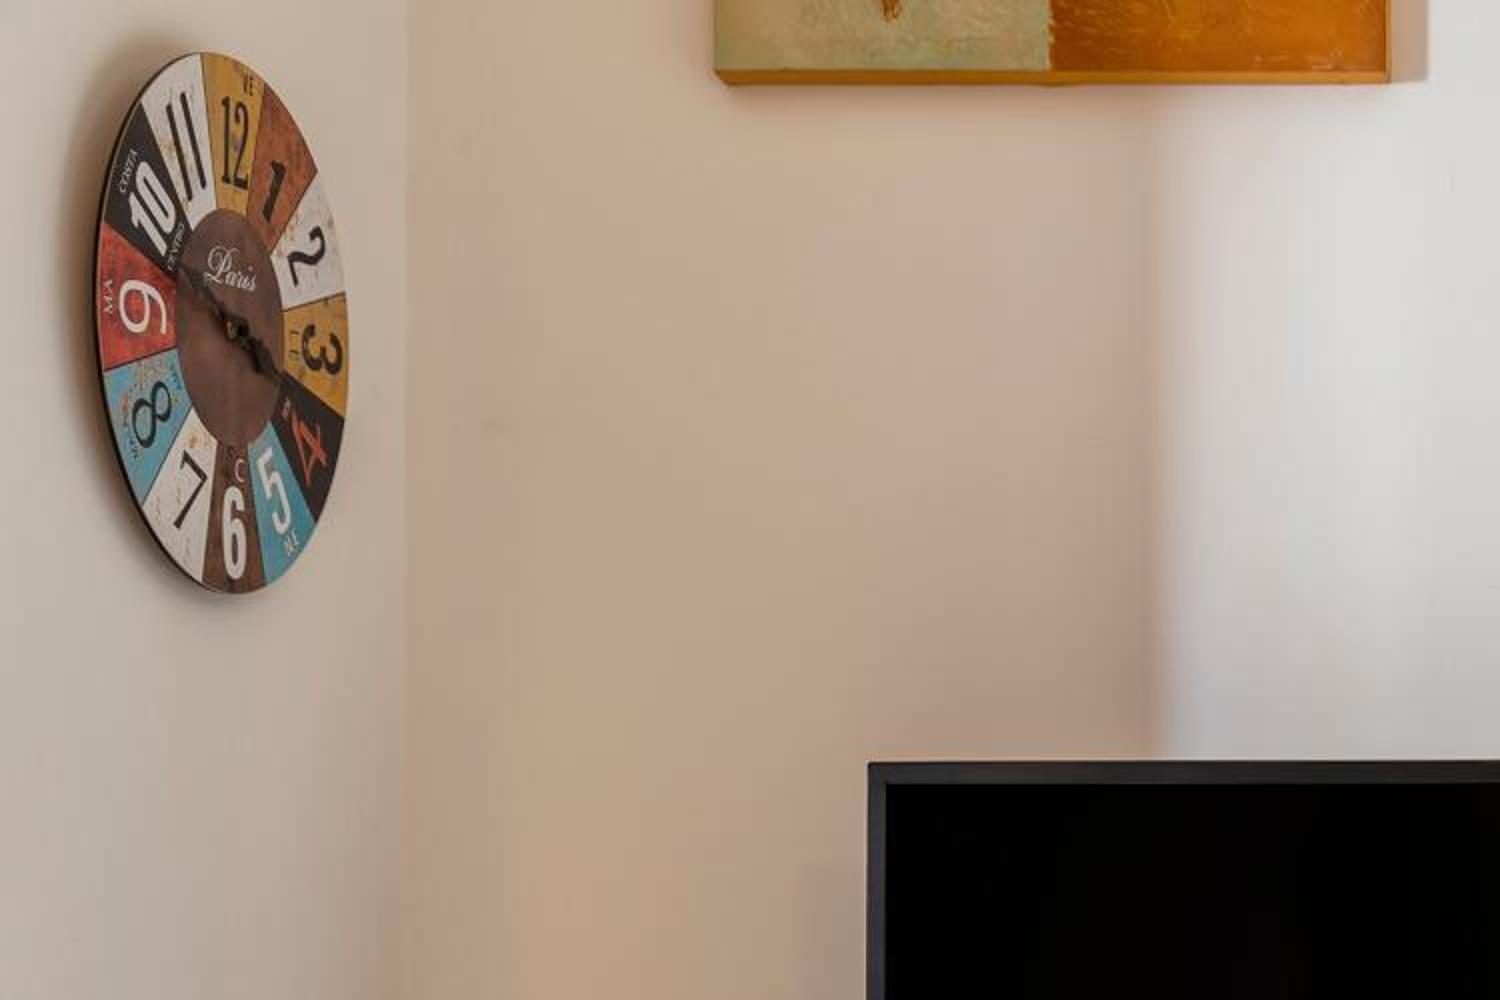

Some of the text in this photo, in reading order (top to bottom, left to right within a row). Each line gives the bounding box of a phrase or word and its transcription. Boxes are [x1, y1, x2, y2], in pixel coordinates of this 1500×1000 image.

[221, 96, 248, 191] 12
[129, 161, 176, 257] 10
[262, 160, 286, 224] 1
[205, 245, 257, 292] Paris
[287, 225, 325, 288] 2
[119, 279, 167, 335] 9
[301, 324, 342, 375] 3
[132, 381, 172, 448] 8
[291, 409, 327, 487] 4
[173, 449, 208, 529] 7
[256, 446, 291, 534] 5
[223, 486, 247, 580] 6
